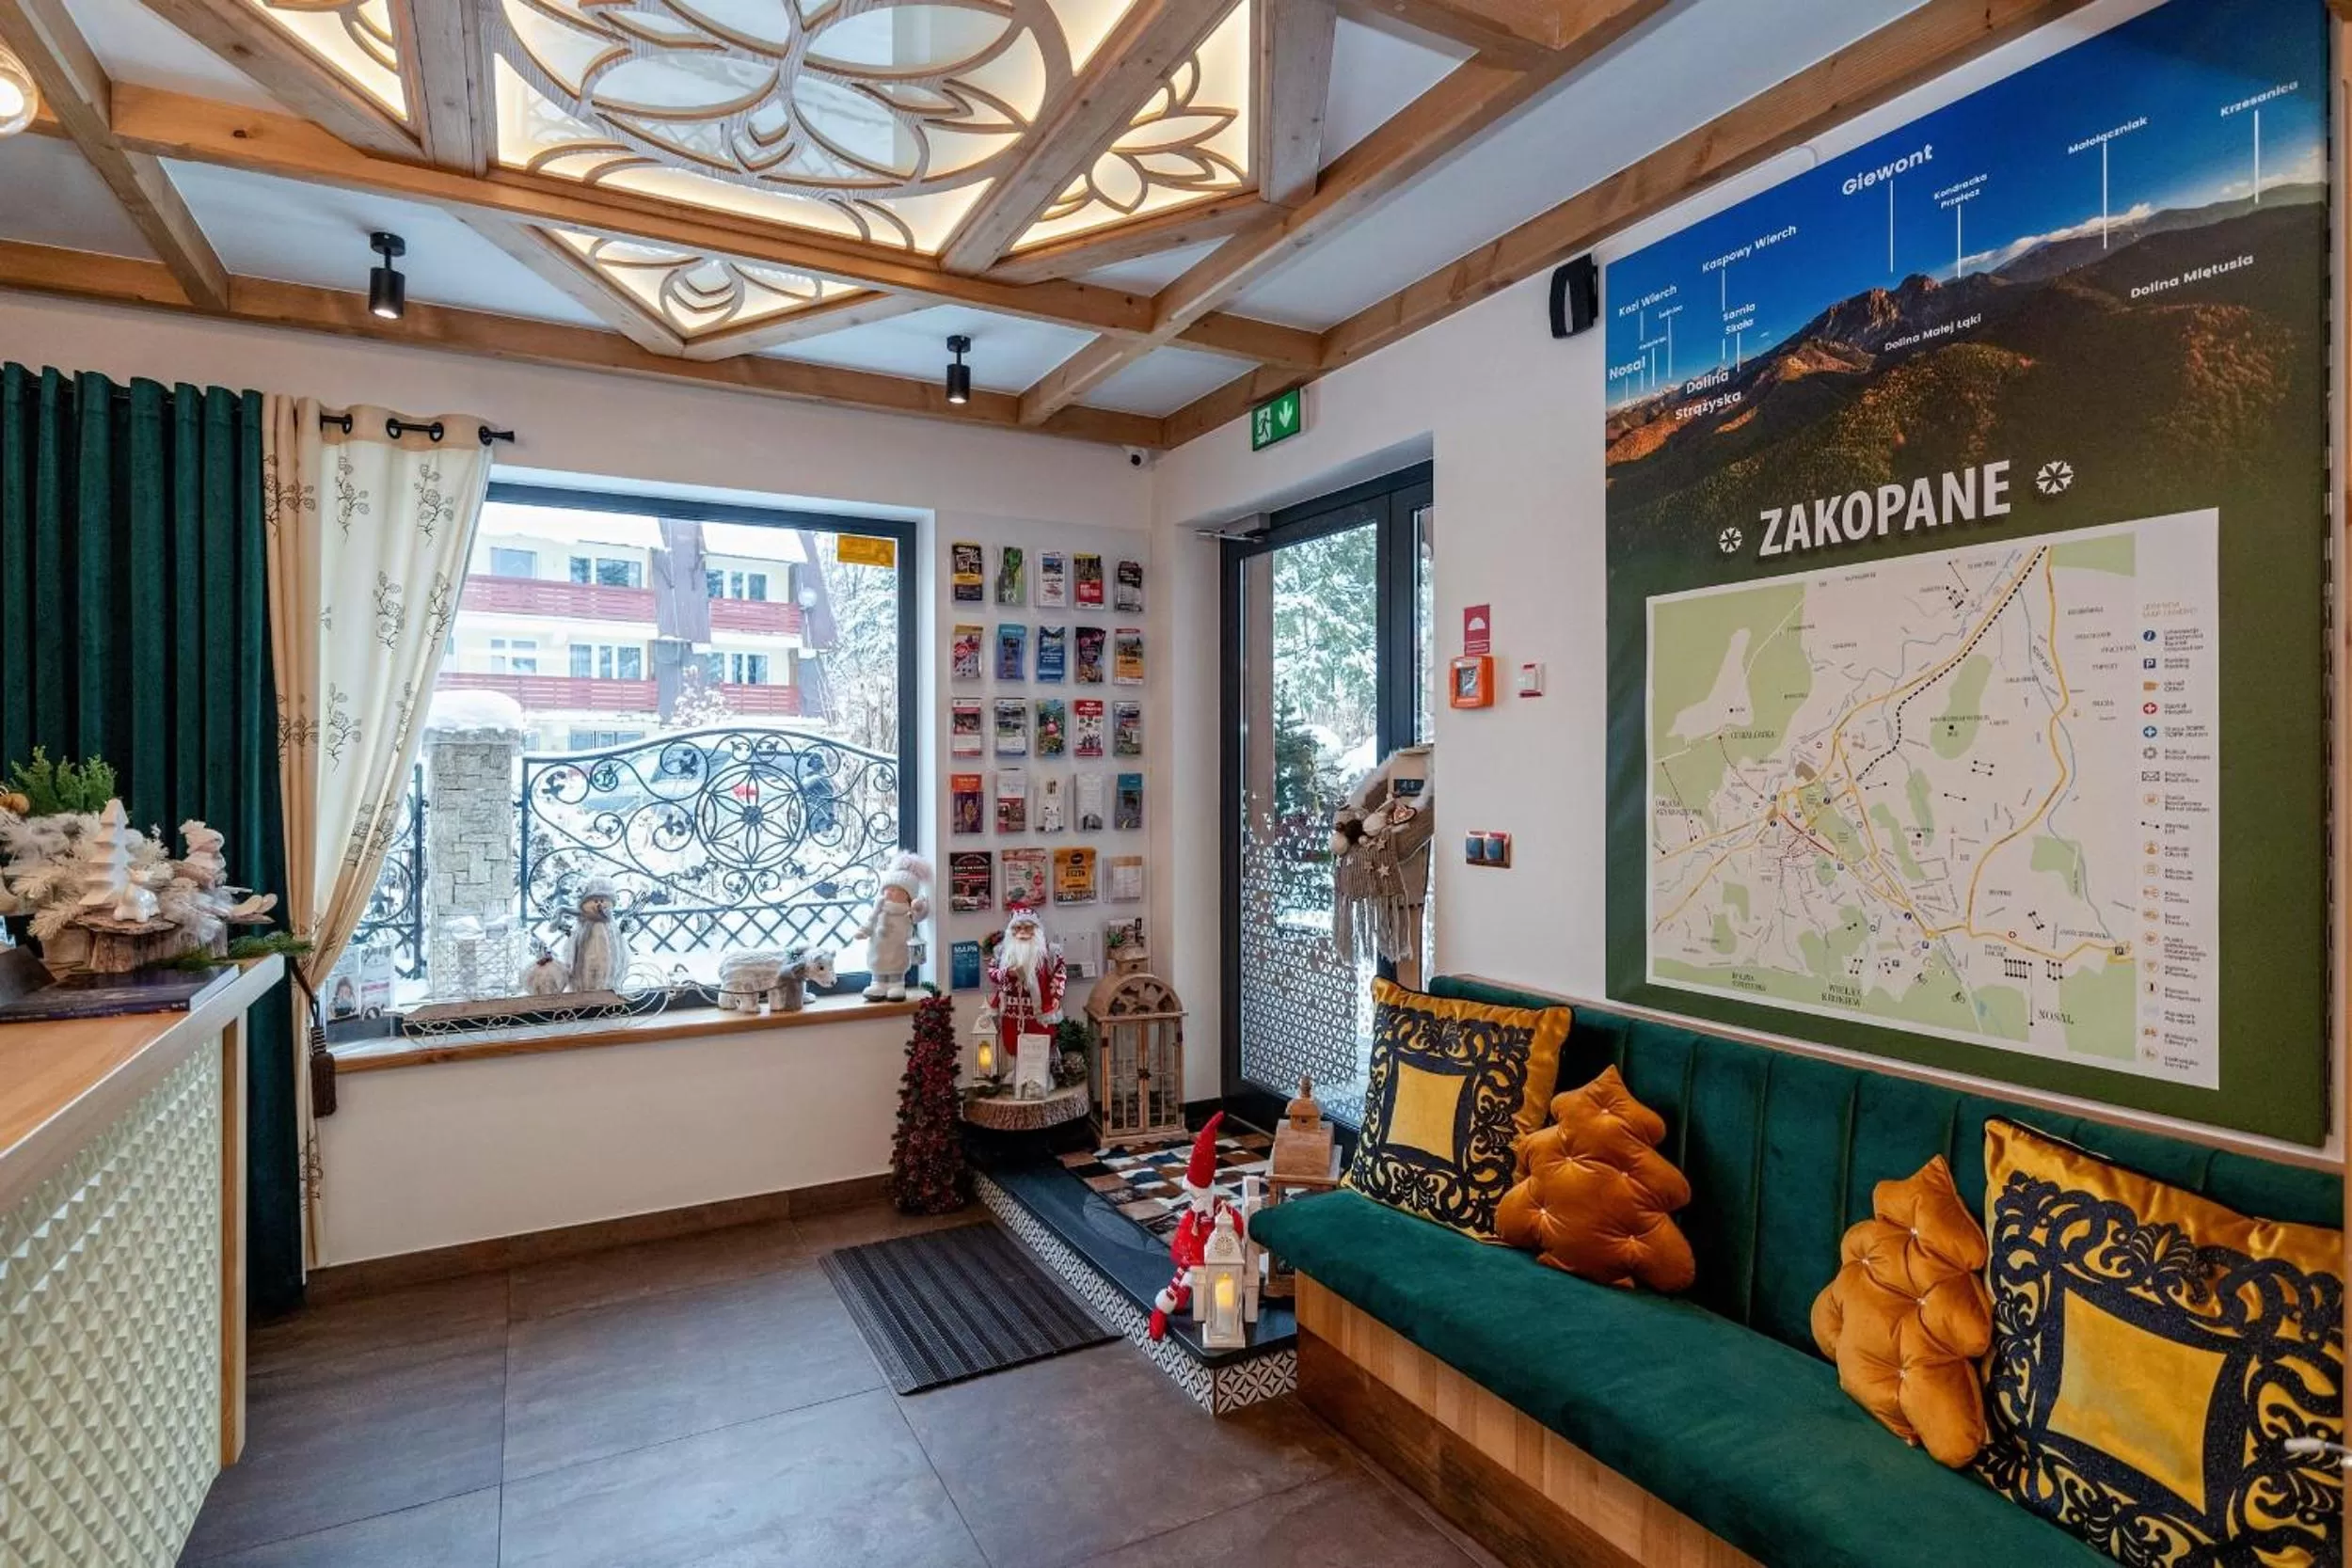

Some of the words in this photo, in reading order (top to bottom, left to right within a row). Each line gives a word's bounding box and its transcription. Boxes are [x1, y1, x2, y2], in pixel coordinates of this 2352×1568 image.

[2220, 81, 2298, 117] Krzesanica
[1842, 142, 1933, 196] Giewont
[1754, 225, 1797, 249] Wierch
[2130, 276, 2180, 299] Dolina
[2183, 254, 2256, 283] Miętusia
[1641, 285, 1677, 308] Wierch
[1884, 334, 1921, 353] Dolina
[1608, 354, 1645, 381] Nosal
[1686, 370, 1729, 395] Dolina
[1674, 390, 1742, 421] Strążyska
[1758, 459, 2012, 558] ZAKOPANE
